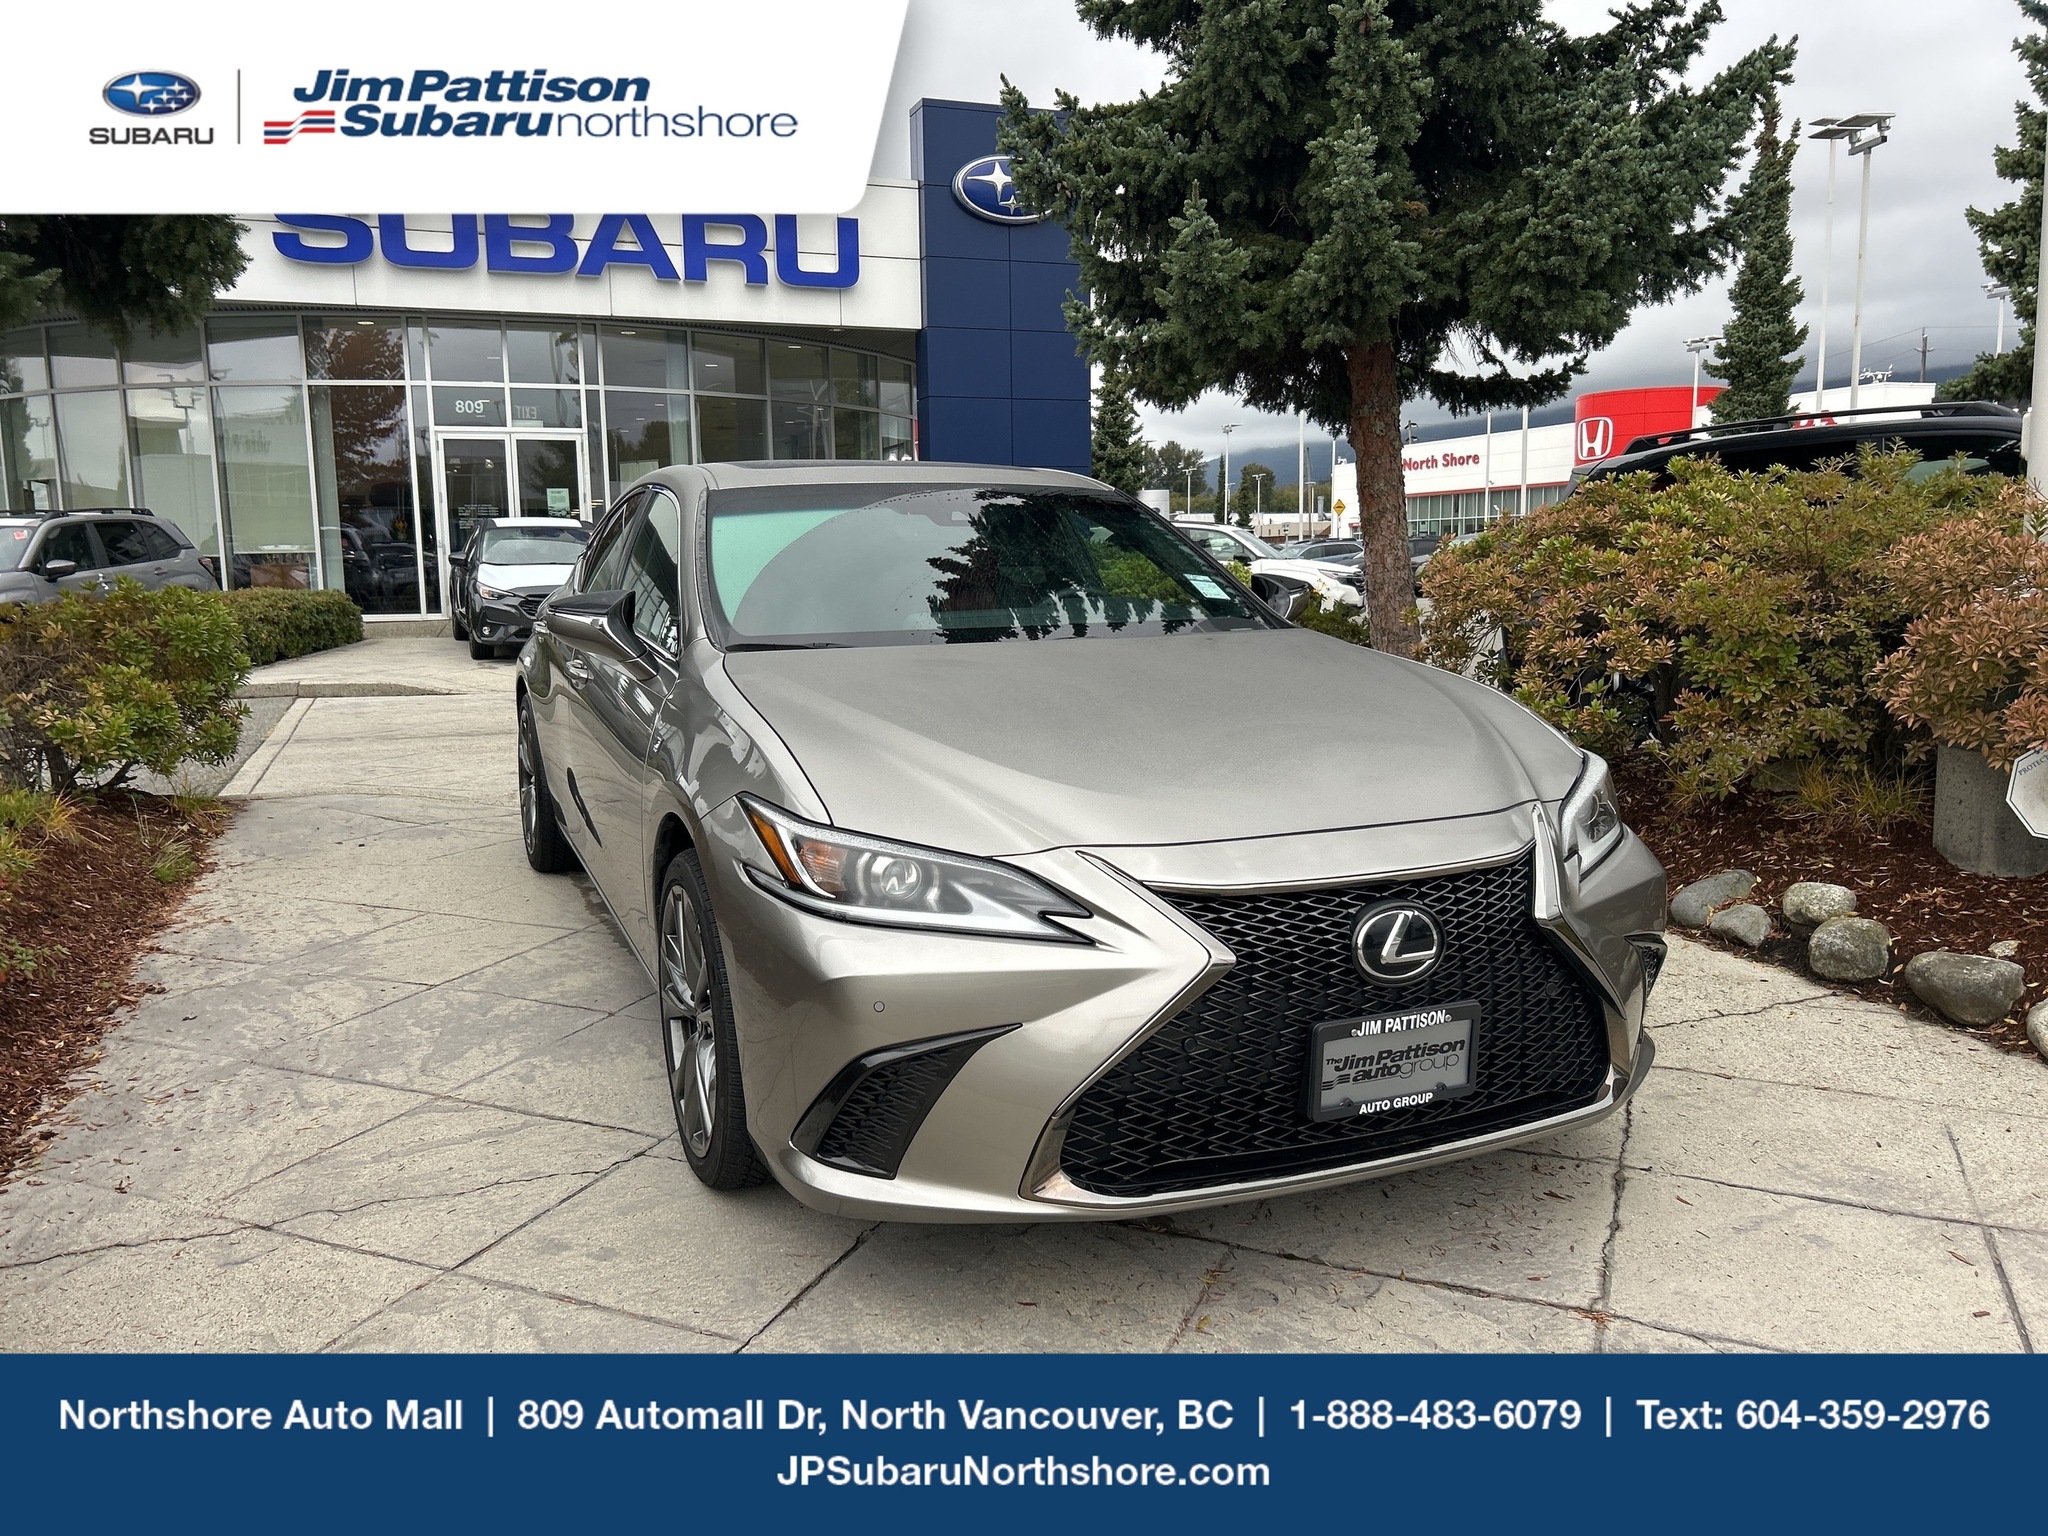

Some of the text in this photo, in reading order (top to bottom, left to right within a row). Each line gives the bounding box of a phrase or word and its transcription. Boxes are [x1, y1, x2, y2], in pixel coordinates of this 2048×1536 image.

[272, 213, 860, 289] SUBARU
[455, 400, 484, 414] 809
[1402, 453, 1480, 471] North Shore
[1357, 1009, 1446, 1037] JIM PATTISON
[1326, 1057, 1343, 1066] The
[1358, 1092, 1434, 1115] AUTO GROUP
